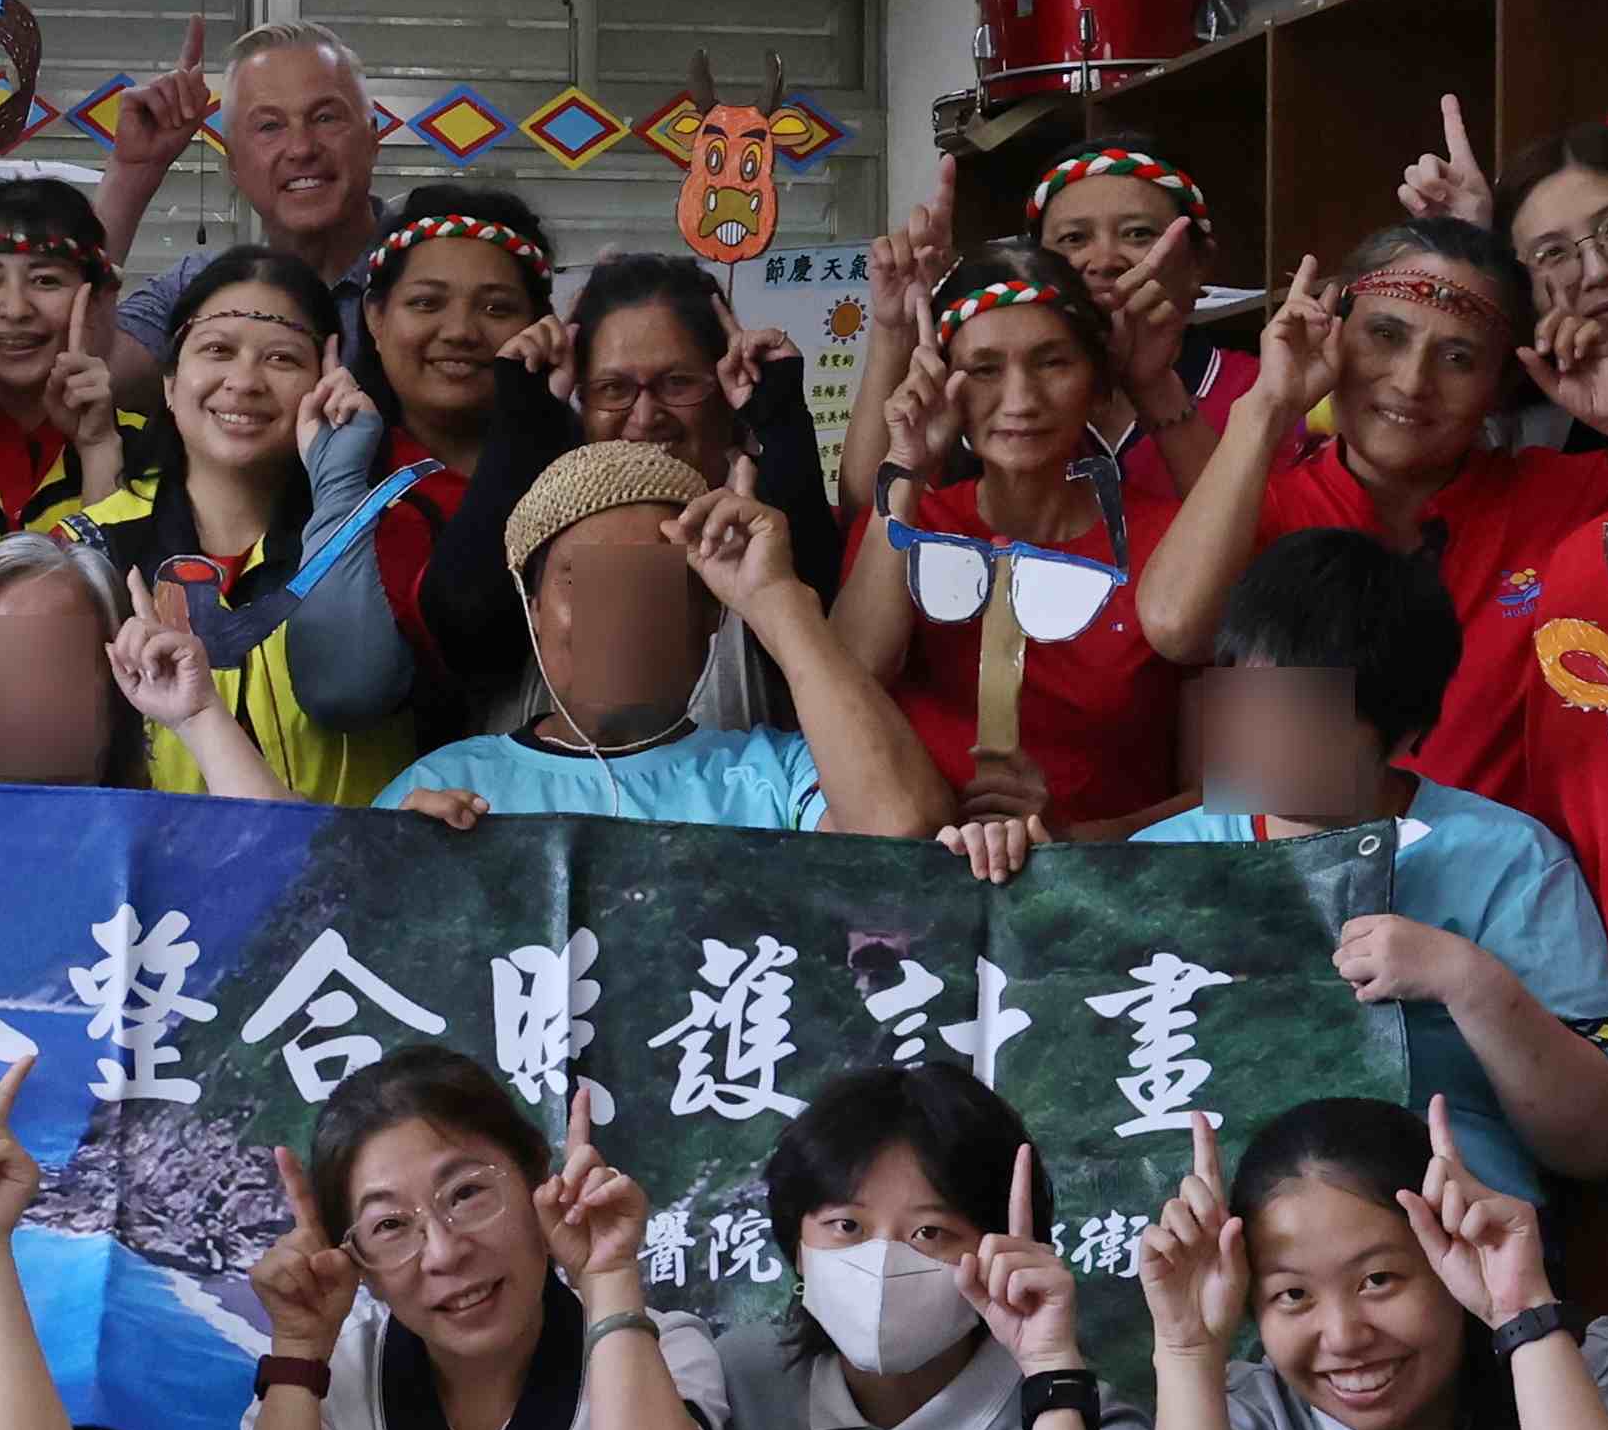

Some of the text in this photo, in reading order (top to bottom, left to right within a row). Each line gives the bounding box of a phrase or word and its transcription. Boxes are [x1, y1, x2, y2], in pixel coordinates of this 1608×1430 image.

[765, 254, 870, 284] 節慶 天氣
[637, 1209, 783, 1287] 醫院
